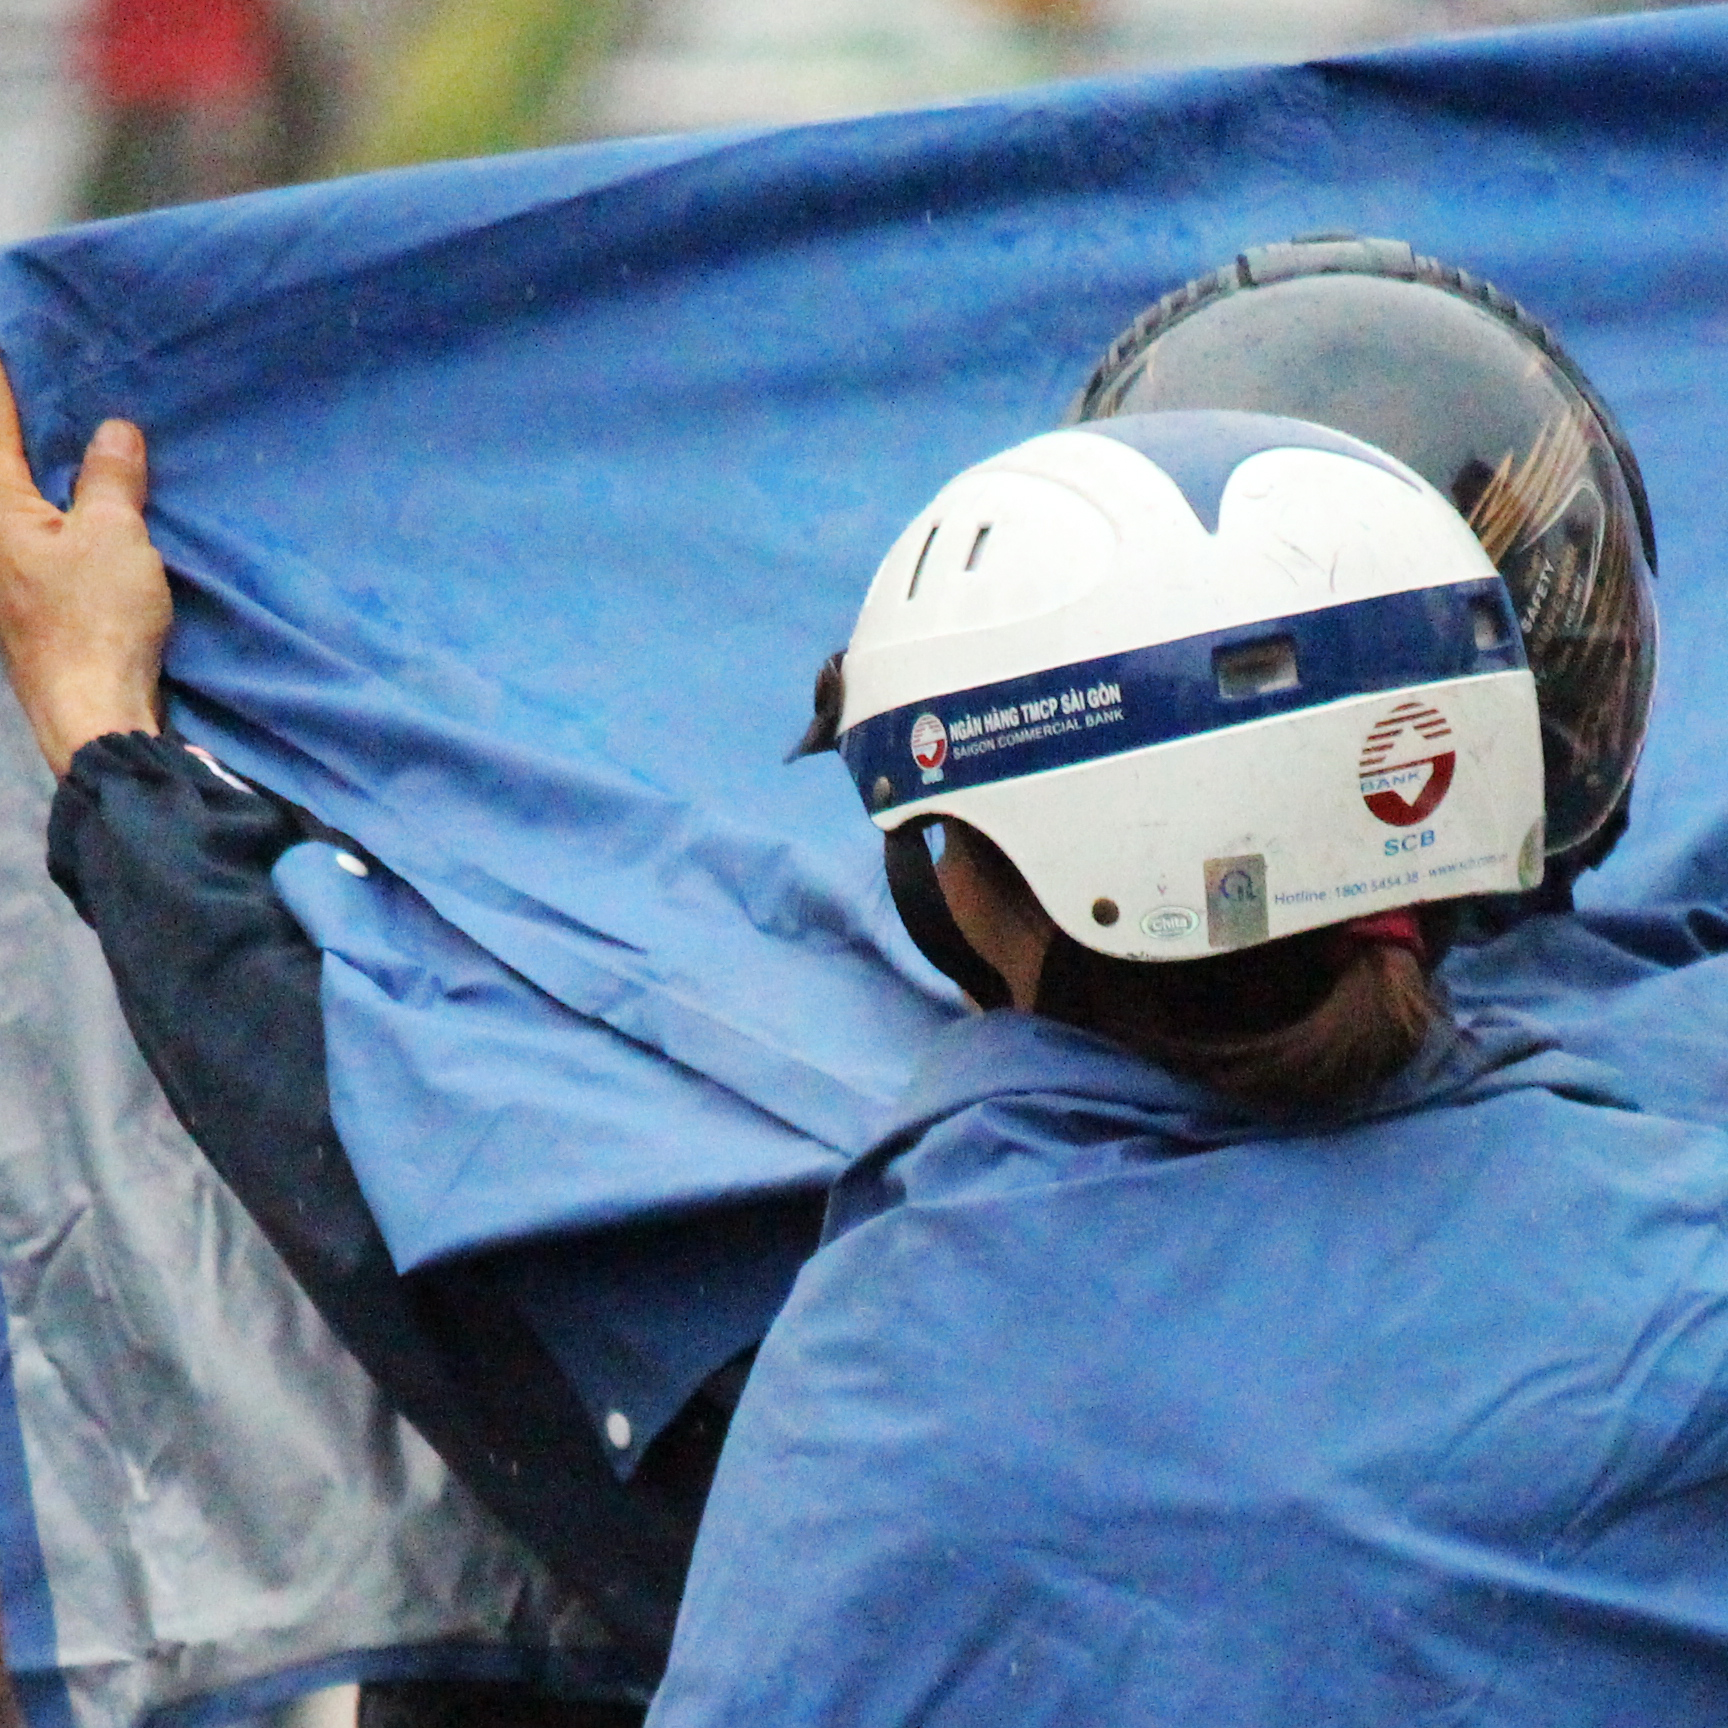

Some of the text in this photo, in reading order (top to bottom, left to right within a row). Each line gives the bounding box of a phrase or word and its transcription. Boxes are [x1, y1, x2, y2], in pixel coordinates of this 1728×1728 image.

[1020, 696, 1058, 724] TMCP
[953, 708, 1125, 760] SAIGON COMMERCIAL BANK
[1360, 771, 1420, 792] BANK
[1384, 830, 1435, 856] SCB
